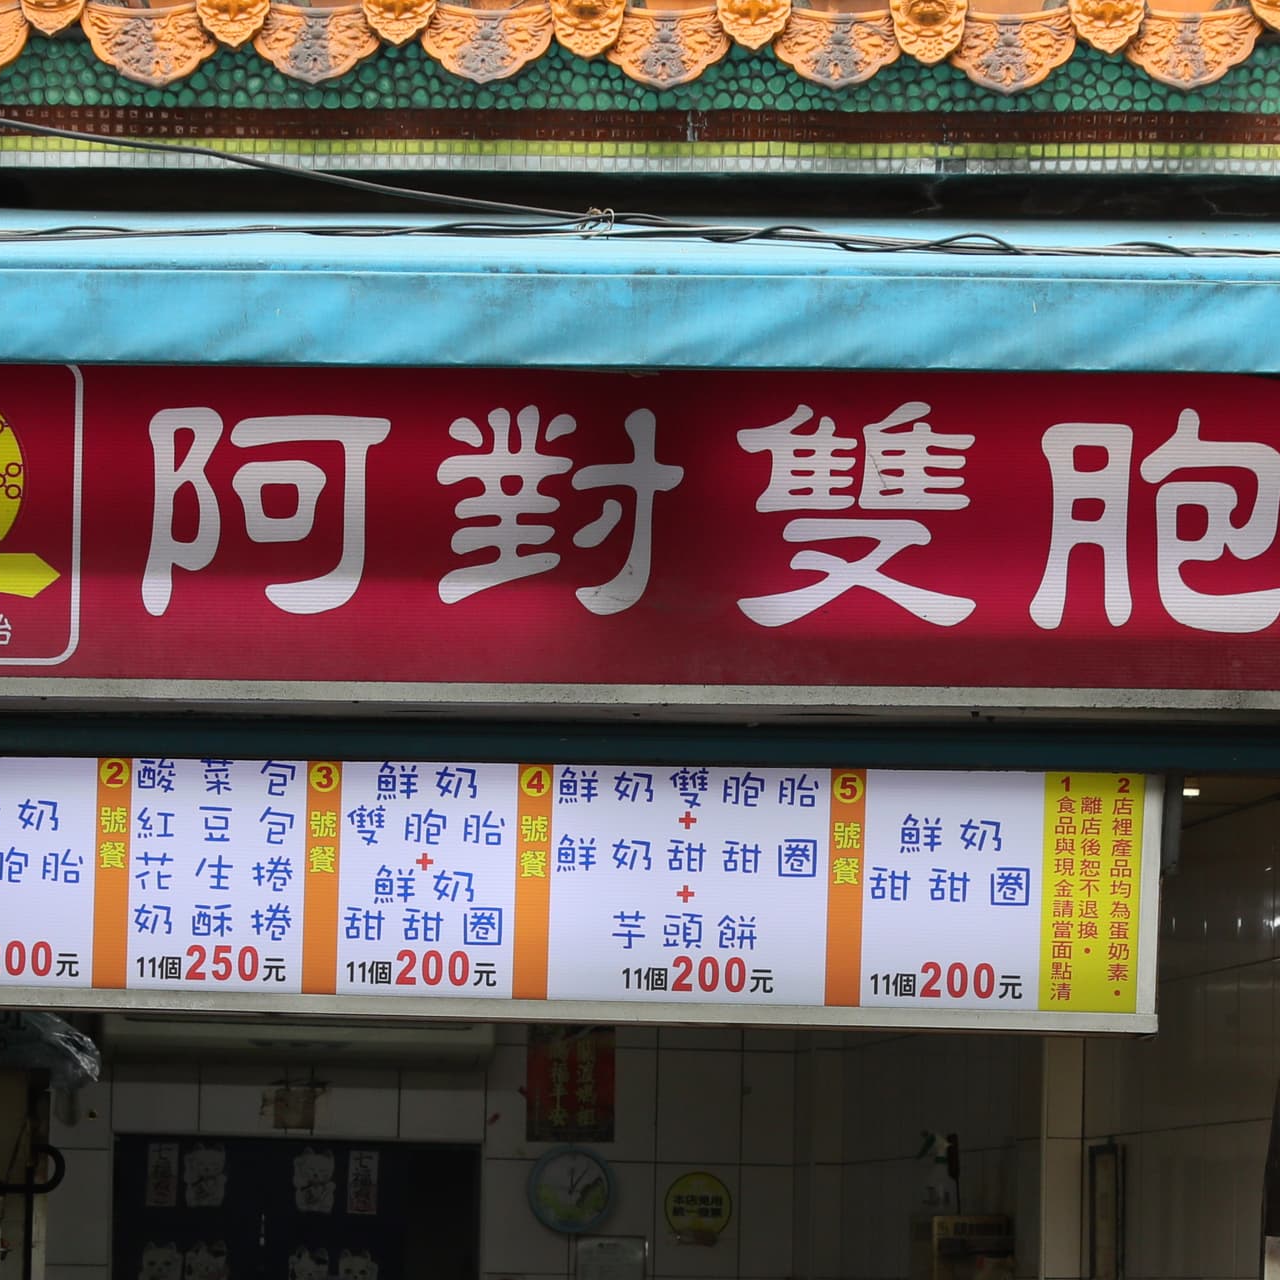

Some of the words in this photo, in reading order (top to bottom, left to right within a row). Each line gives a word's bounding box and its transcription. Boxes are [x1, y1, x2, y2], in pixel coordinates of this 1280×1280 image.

[136, 758, 296, 796] 酸菜包
[376, 761, 478, 800] 鮮奶
[558, 766, 820, 808] 鮮奶雙胞胎
[136, 806, 295, 845] 紅豆包
[347, 804, 505, 846] 雙胞胎
[900, 813, 1002, 854] 鮮奶
[135, 851, 294, 892] 花生捲
[556, 833, 818, 878] 鮮奶甜甜圈
[373, 864, 475, 905] 鮮奶
[870, 867, 1031, 907] 甜甜圈
[134, 903, 292, 942] 奶酥捲
[344, 906, 503, 947] 甜甜圈
[612, 910, 758, 951] 芋頭餅
[136, 944, 287, 982] 11個250元
[346, 949, 497, 988] 11個200元
[622, 955, 774, 994] 11個200元
[870, 961, 1023, 1000] 11個200元
